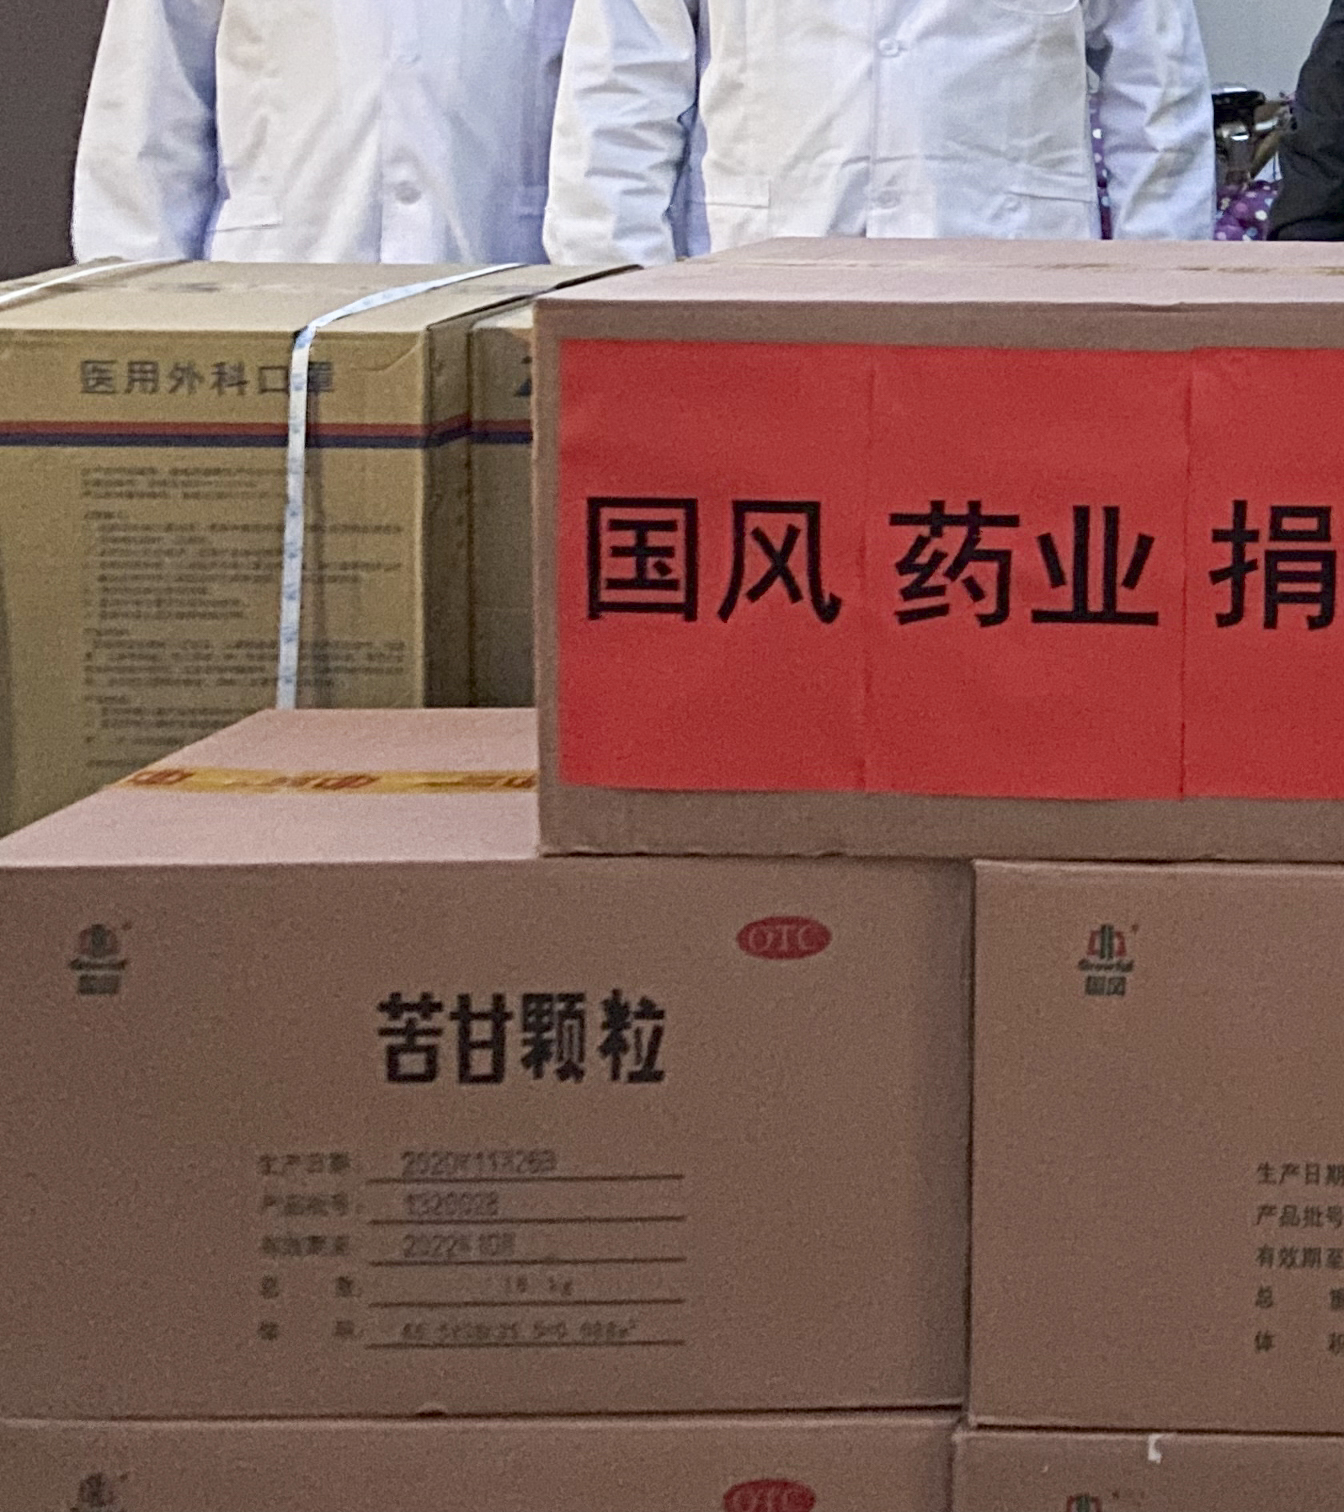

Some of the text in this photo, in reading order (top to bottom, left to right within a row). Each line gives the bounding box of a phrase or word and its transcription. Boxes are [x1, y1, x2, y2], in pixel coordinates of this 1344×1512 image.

[80, 359, 334, 396] 医用外科口罩
[378, 988, 666, 1085] 苦甘颗粒
